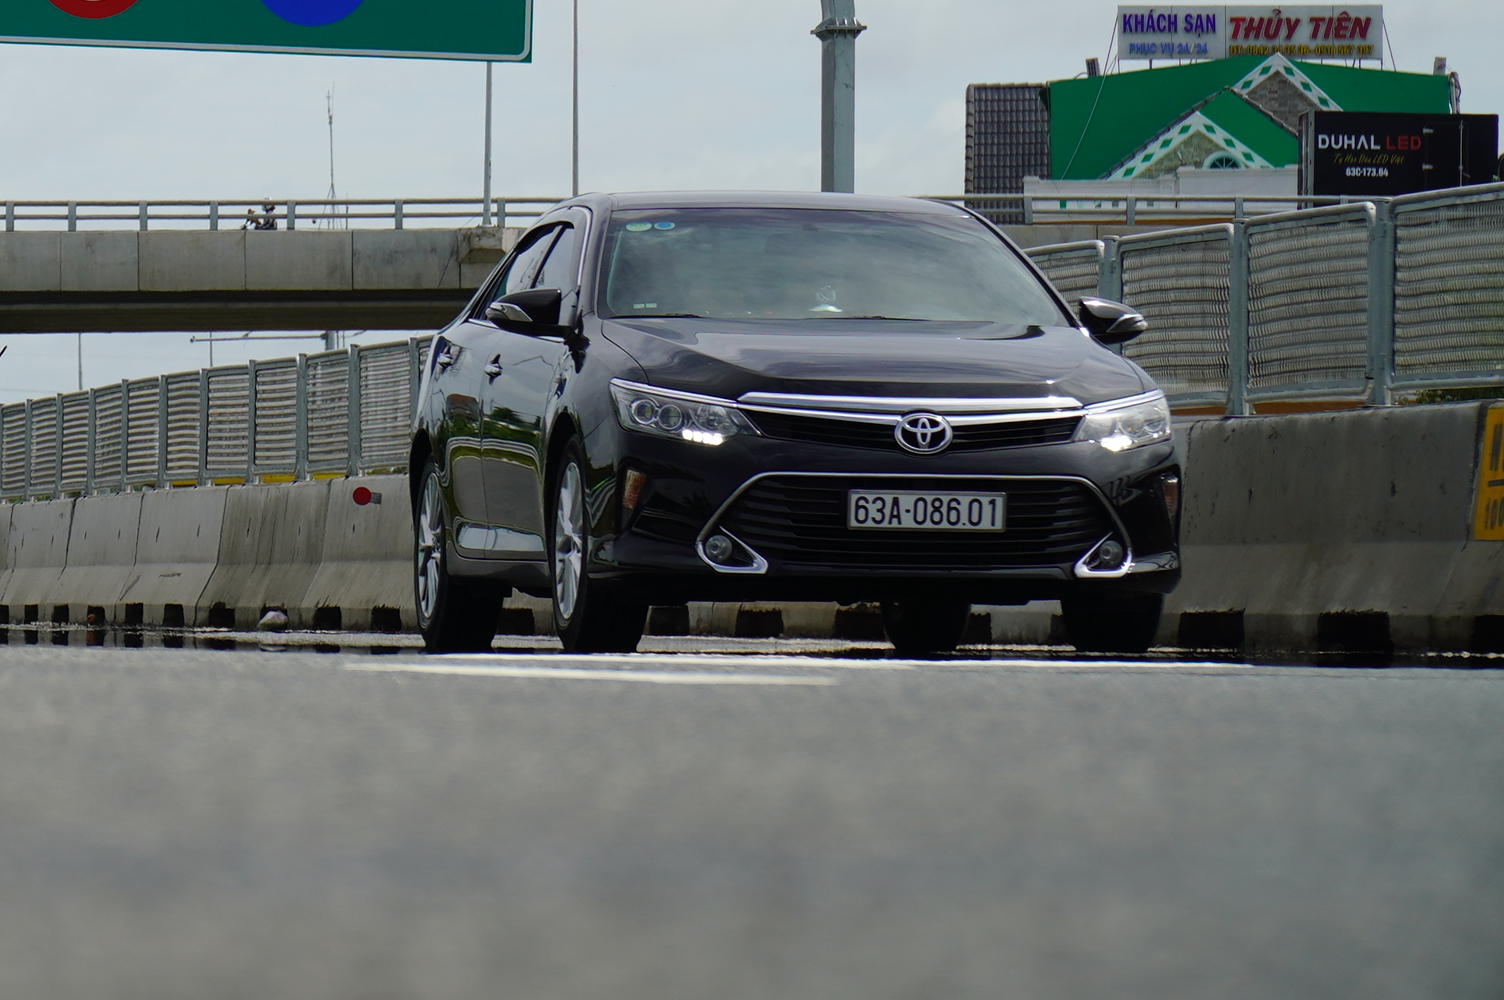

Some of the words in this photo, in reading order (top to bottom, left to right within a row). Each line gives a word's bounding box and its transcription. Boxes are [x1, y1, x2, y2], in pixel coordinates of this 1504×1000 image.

[1122, 9, 1178, 34] KHÁCH
[1183, 13, 1217, 38] SẠN
[1229, 8, 1301, 41] THỦY
[1309, 10, 1372, 40] TIÊN
[1318, 134, 1381, 150] DUHAL
[1386, 136, 1422, 150] LED
[854, 496, 997, 527] 63A-086.01
